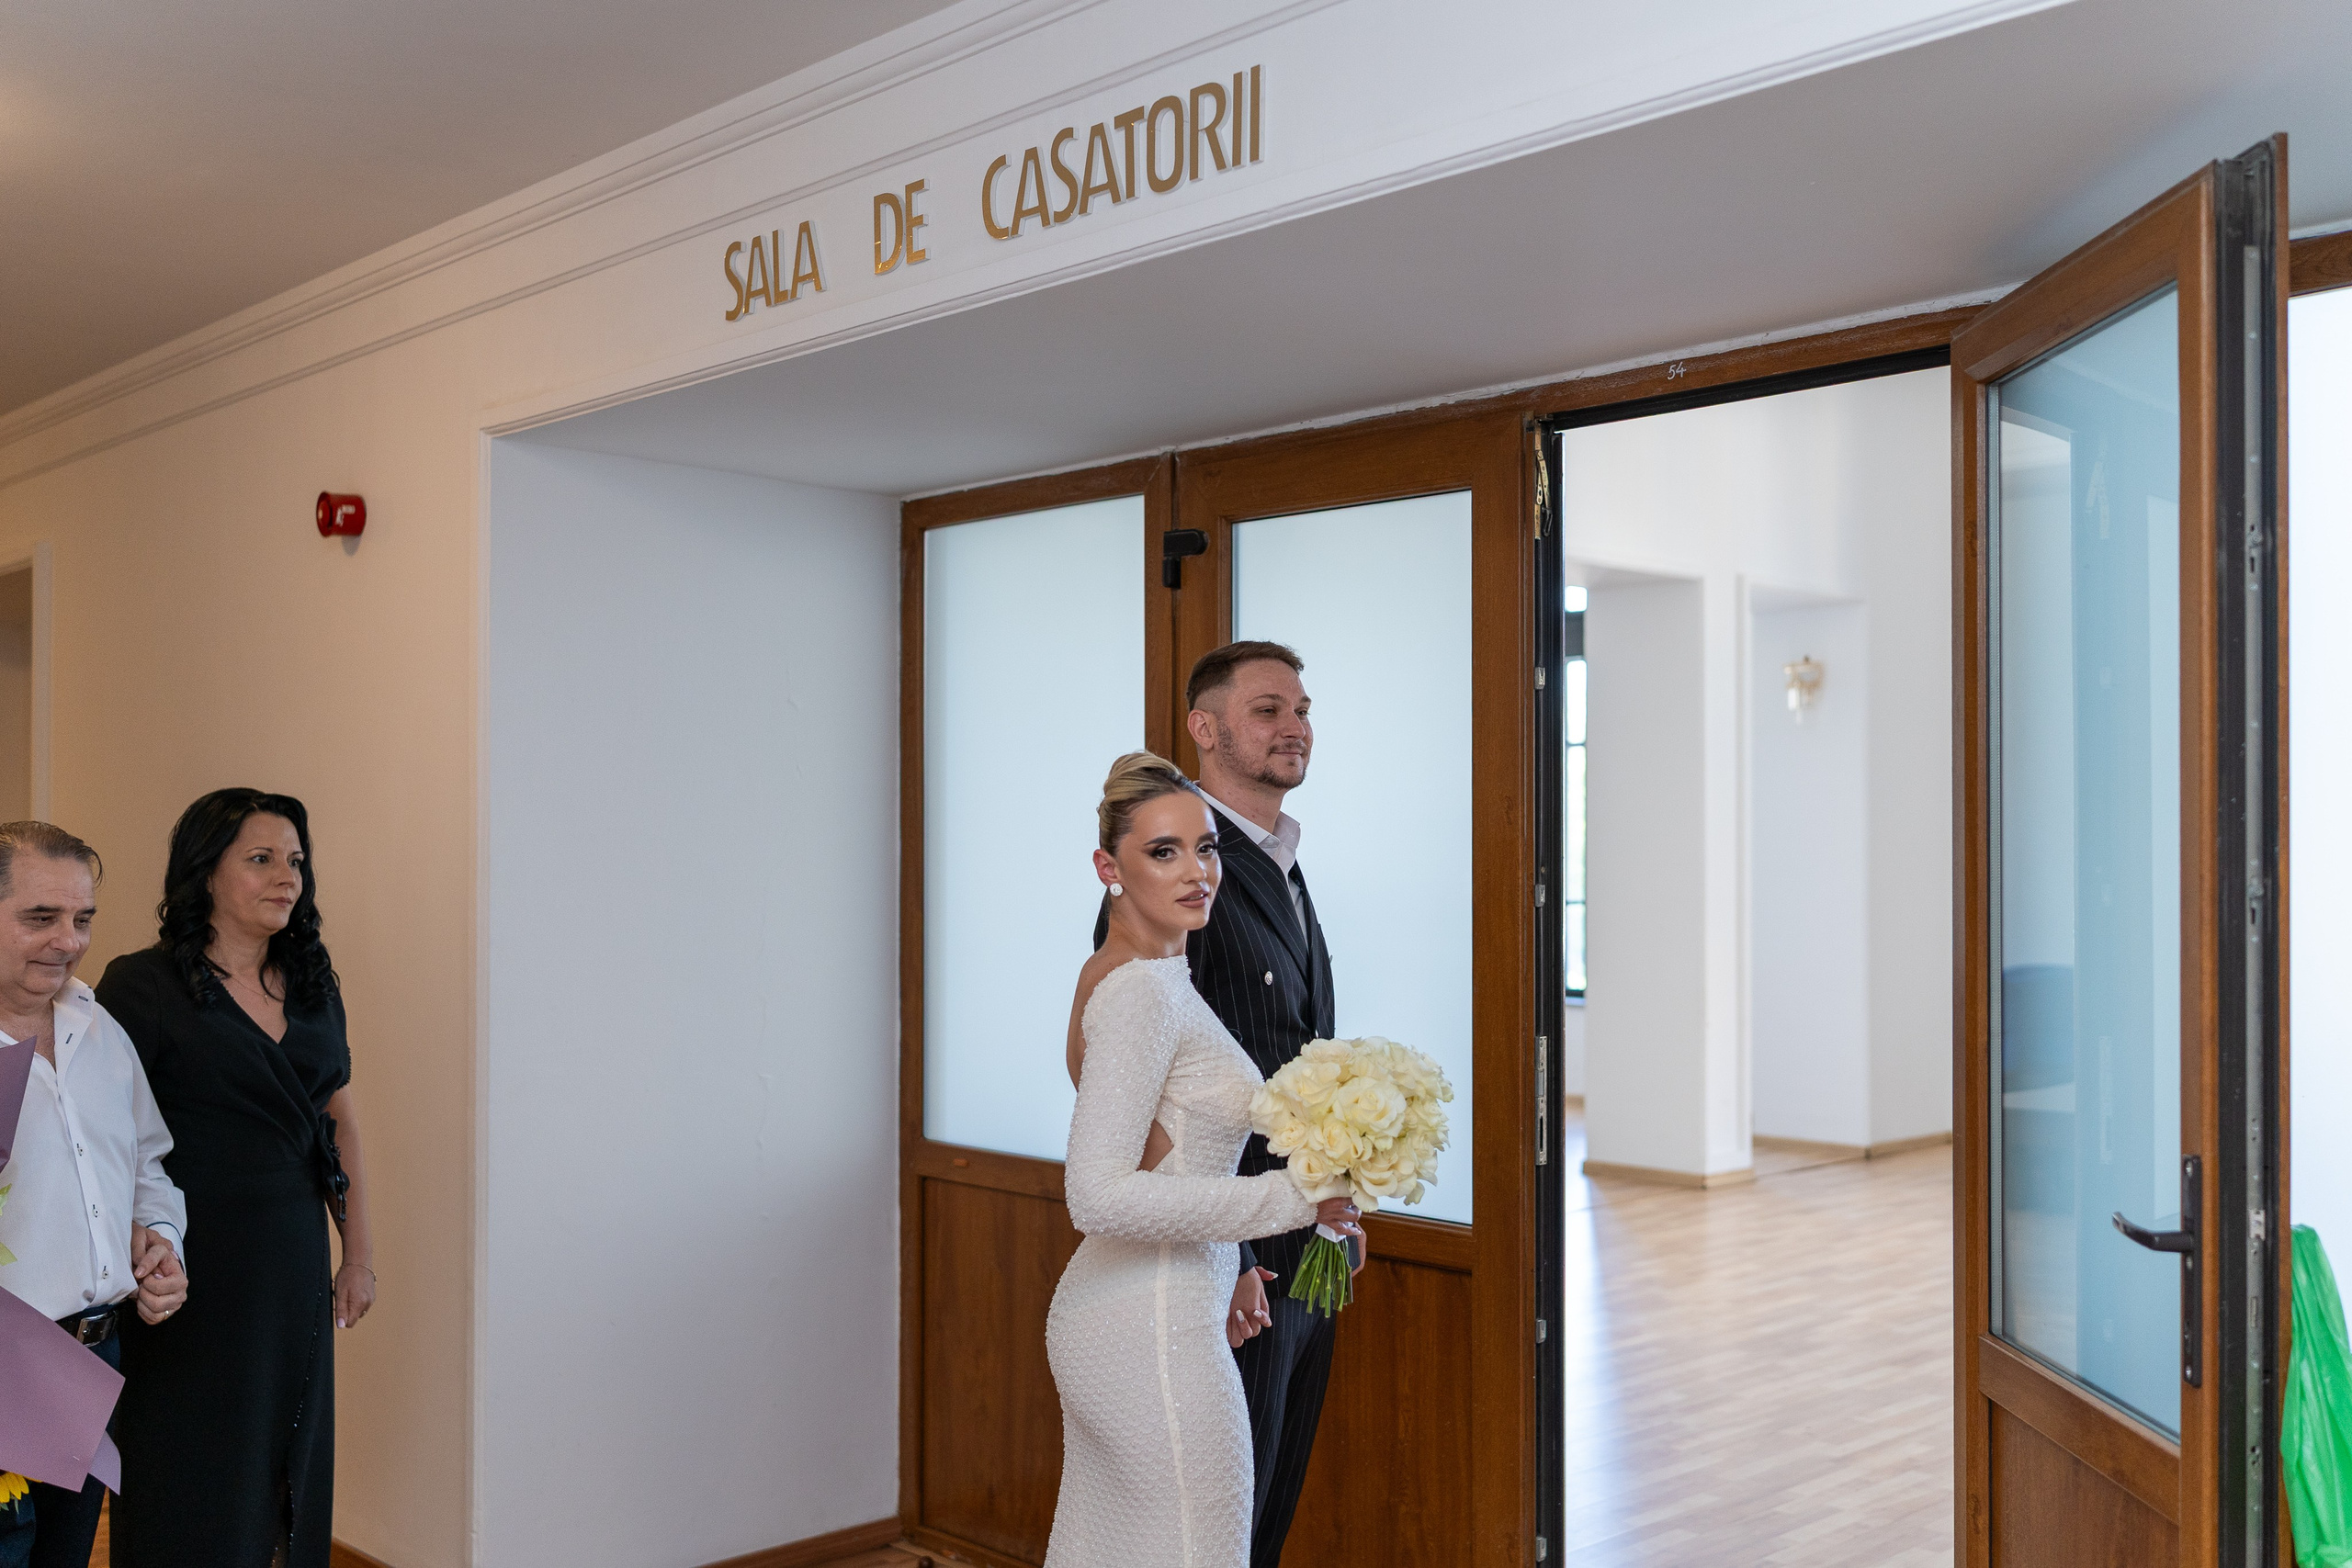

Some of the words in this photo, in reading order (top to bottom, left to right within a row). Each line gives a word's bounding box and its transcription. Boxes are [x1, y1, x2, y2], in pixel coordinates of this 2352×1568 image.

[723, 220, 825, 322] SALA
[873, 178, 929, 276] DE
[981, 64, 1262, 241] CASATORII
[1667, 361, 1687, 380] 54
